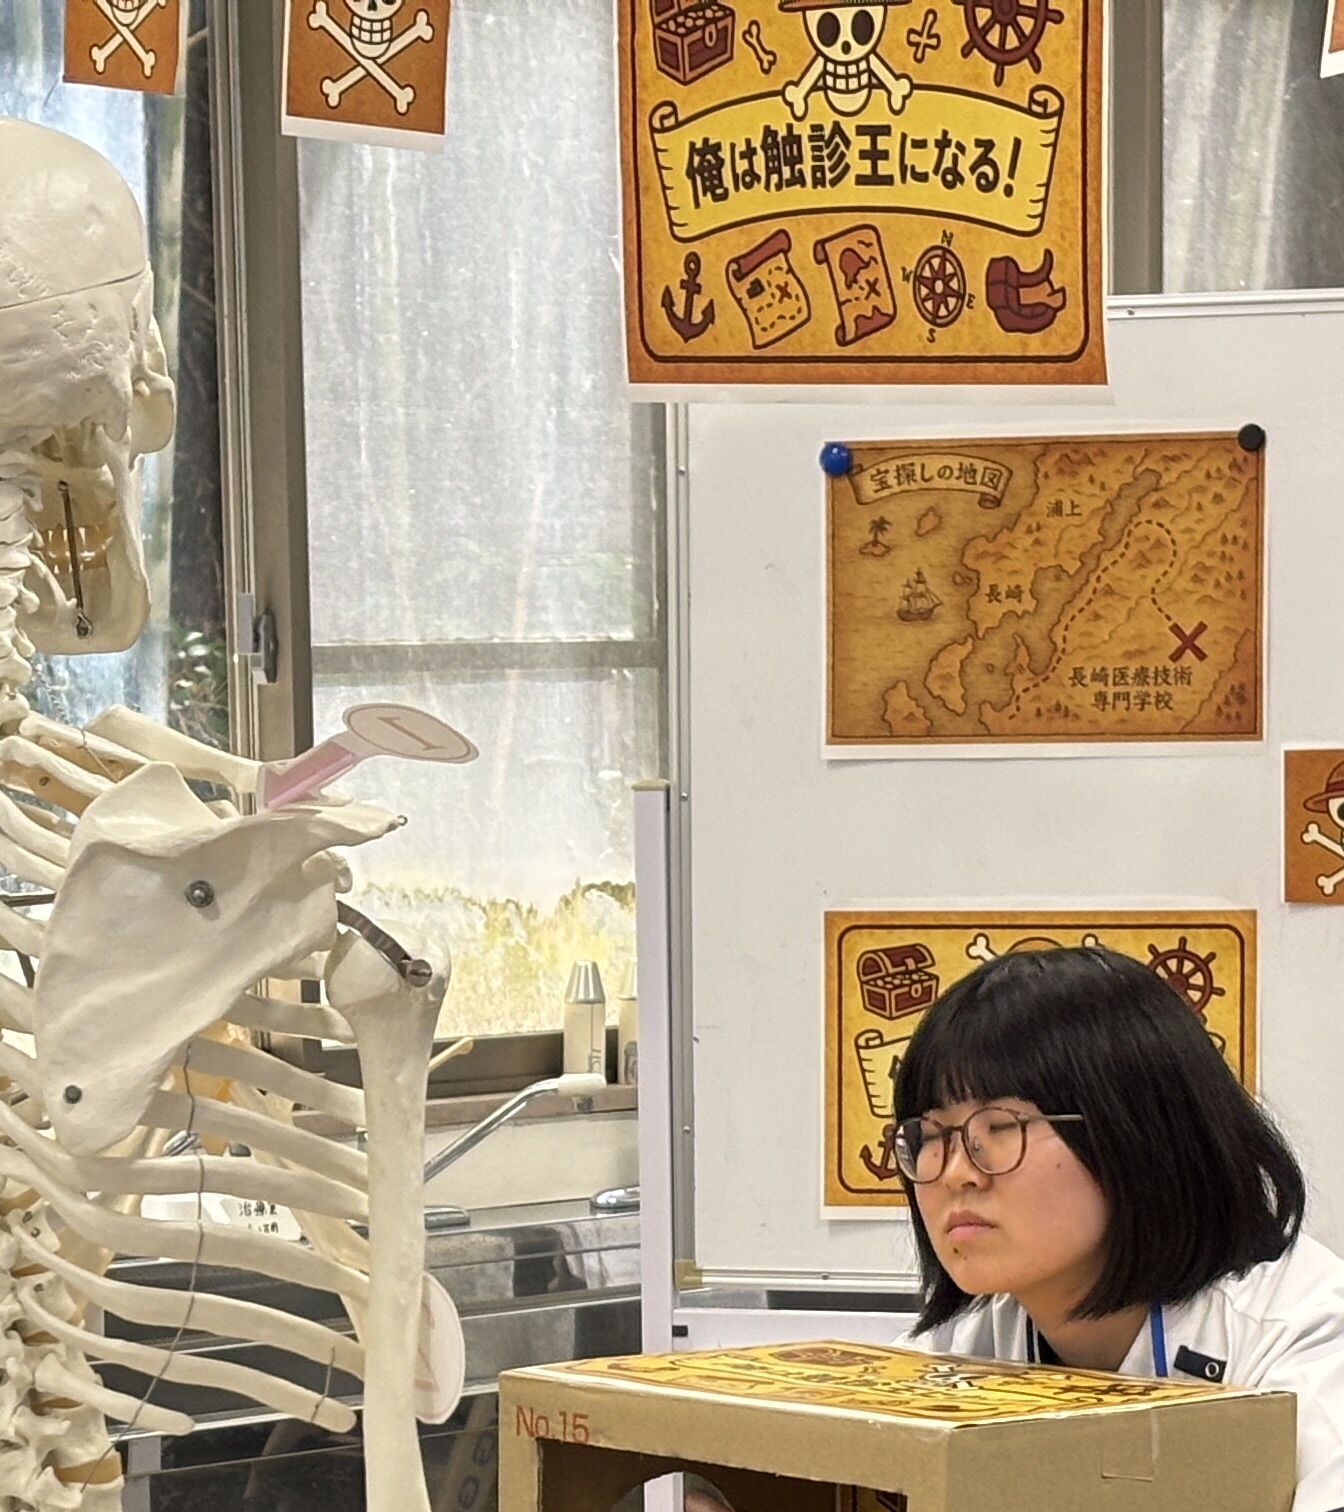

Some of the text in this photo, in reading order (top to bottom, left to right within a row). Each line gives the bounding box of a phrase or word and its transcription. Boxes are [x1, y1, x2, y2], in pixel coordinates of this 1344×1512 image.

[685, 121, 1022, 209] 俺は触診王になる!
[941, 230, 954, 247] N
[901, 266, 916, 284] W
[966, 295, 975, 311] E
[926, 328, 936, 343] S
[869, 462, 1003, 494] 宝探しの地図
[1045, 500, 1083, 518] 浦上
[984, 584, 1025, 605] 長崎
[1068, 665, 1194, 687] 長崎医療技術
[1092, 690, 1174, 713] 専門学校
